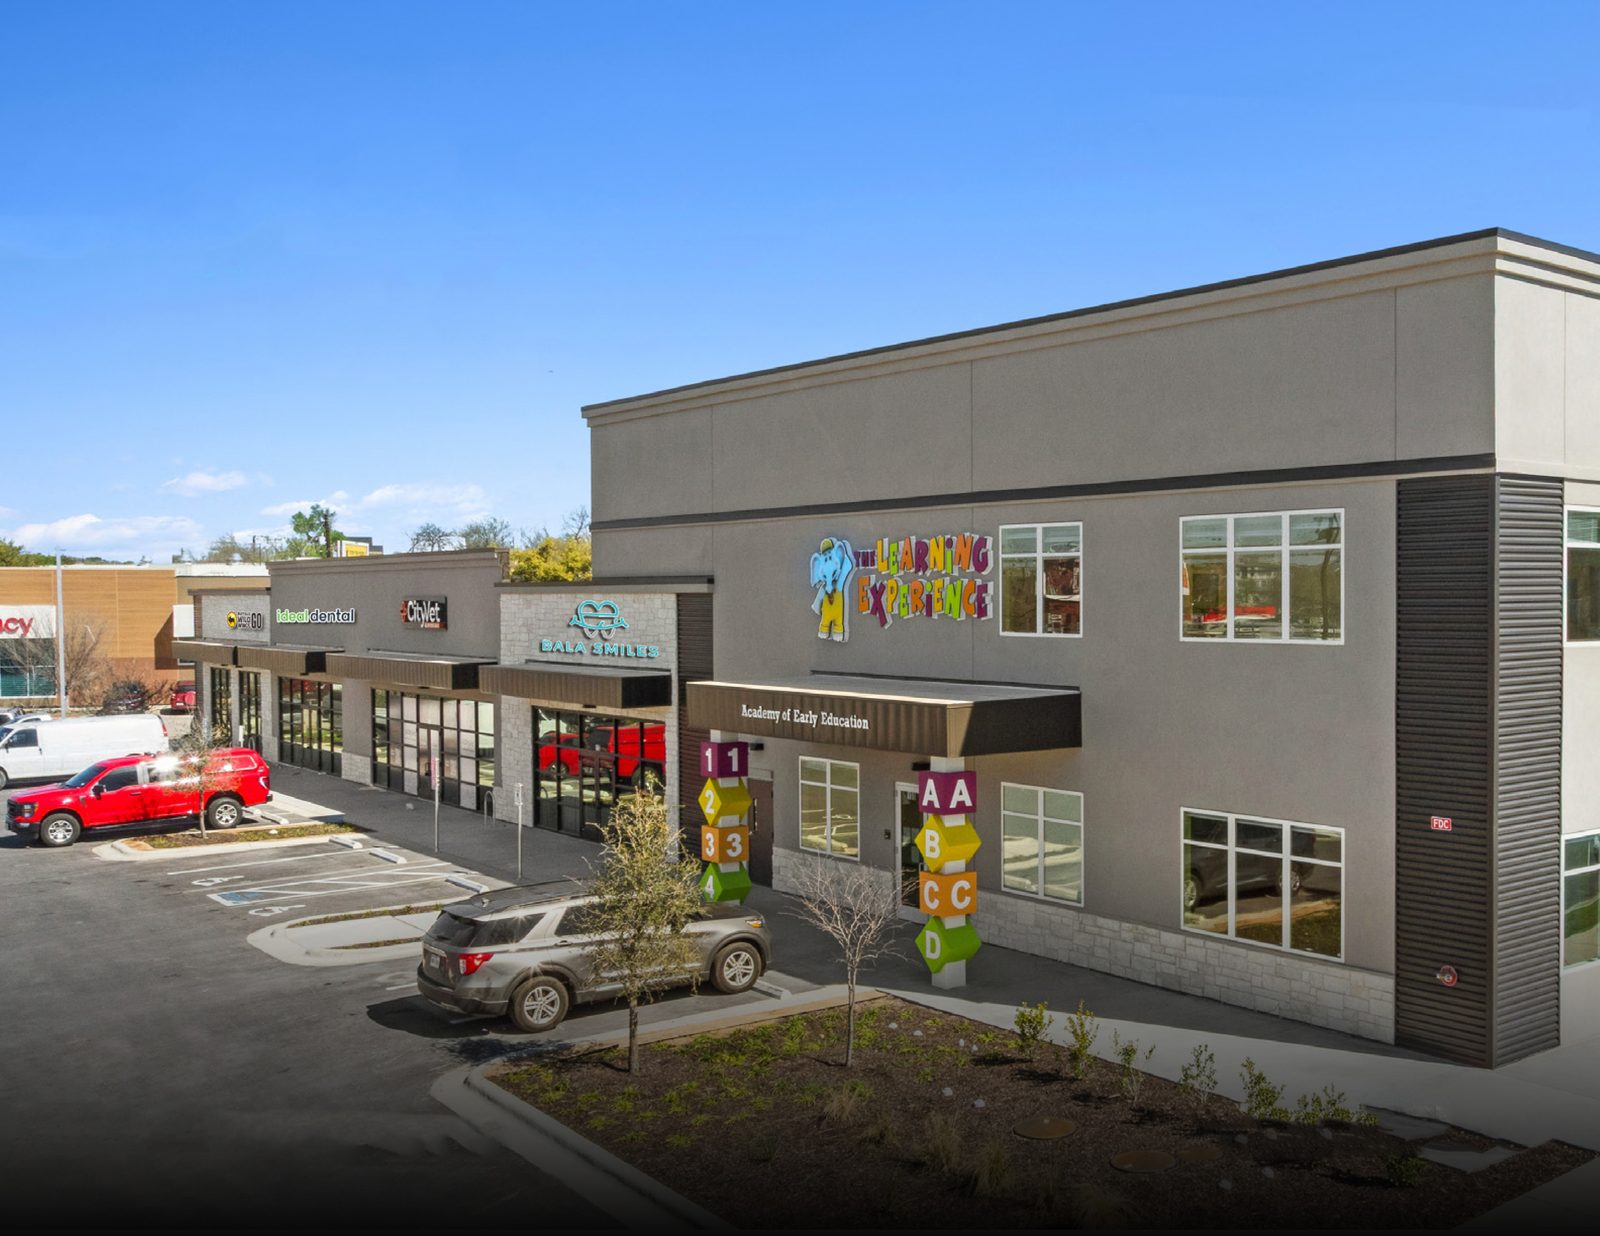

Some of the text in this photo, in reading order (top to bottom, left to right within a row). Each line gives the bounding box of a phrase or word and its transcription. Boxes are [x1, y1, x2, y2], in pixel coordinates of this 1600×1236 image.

[854, 549, 876, 567] THE
[251, 612, 262, 628] GO
[276, 608, 355, 623] ideal dental
[407, 600, 440, 628] CityVet
[0, 617, 33, 638] cy
[541, 639, 660, 658] BALA SMILES
[741, 704, 869, 730] Academy of Early Education
[705, 748, 712, 772] 1
[727, 748, 738, 772] 1
[705, 790, 715, 814] 2
[922, 779, 940, 808] A
[949, 779, 973, 808] A
[1433, 818, 1450, 829] FDC
[705, 832, 715, 857] 3
[726, 832, 742, 858] 3
[925, 829, 941, 859] B
[704, 875, 715, 899] 4
[923, 880, 939, 909] C
[951, 880, 971, 909] C
[925, 930, 941, 960] D
